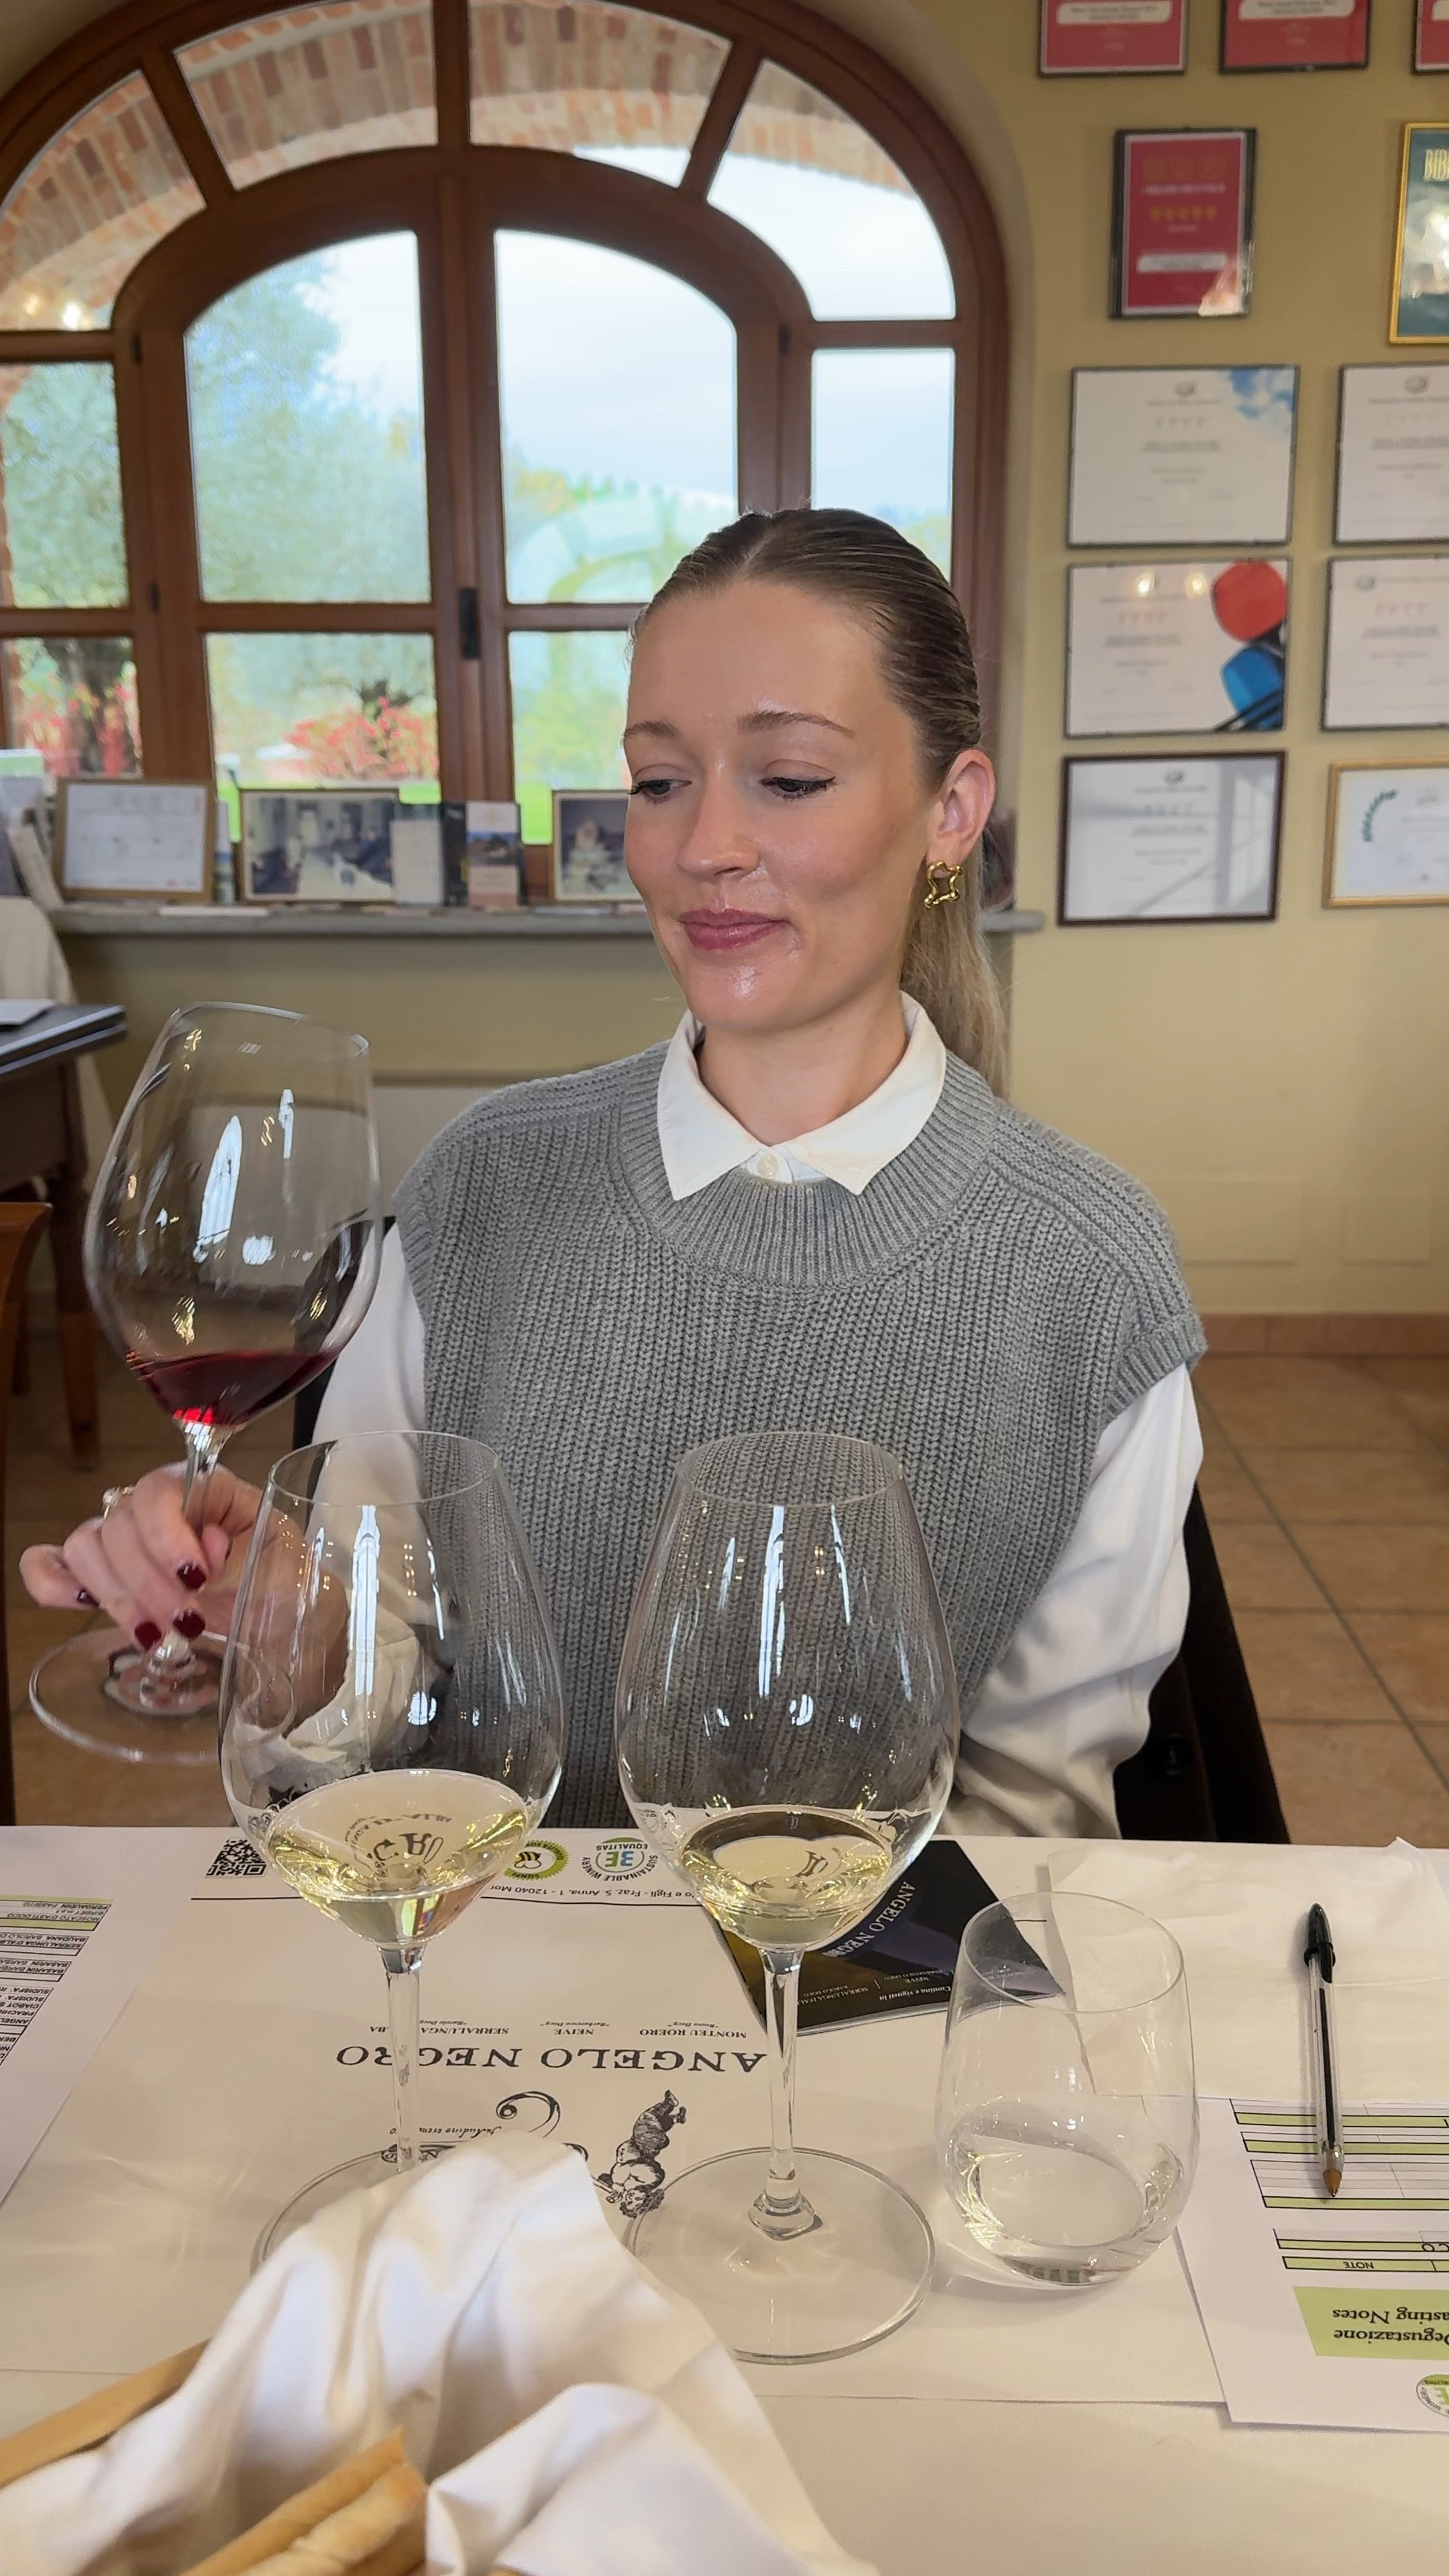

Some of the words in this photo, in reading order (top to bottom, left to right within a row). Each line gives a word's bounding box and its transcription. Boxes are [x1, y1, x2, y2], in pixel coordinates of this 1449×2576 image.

[604, 1851, 634, 1867] 3E
[582, 1856, 602, 1880] WINERY
[603, 1855, 658, 1882] SUSTAINABLE
[651, 1890, 672, 1898] Figli
[869, 1881, 916, 1931] ANGELO
[690, 2029, 747, 2039] MONTEU
[336, 2046, 523, 2068] NEGRO
[541, 2048, 767, 2073] ANGELO
[1343, 2261, 1375, 2269] NOTE
[1332, 2310, 1390, 2324] Notes
[1395, 2307, 1449, 2324] asting
